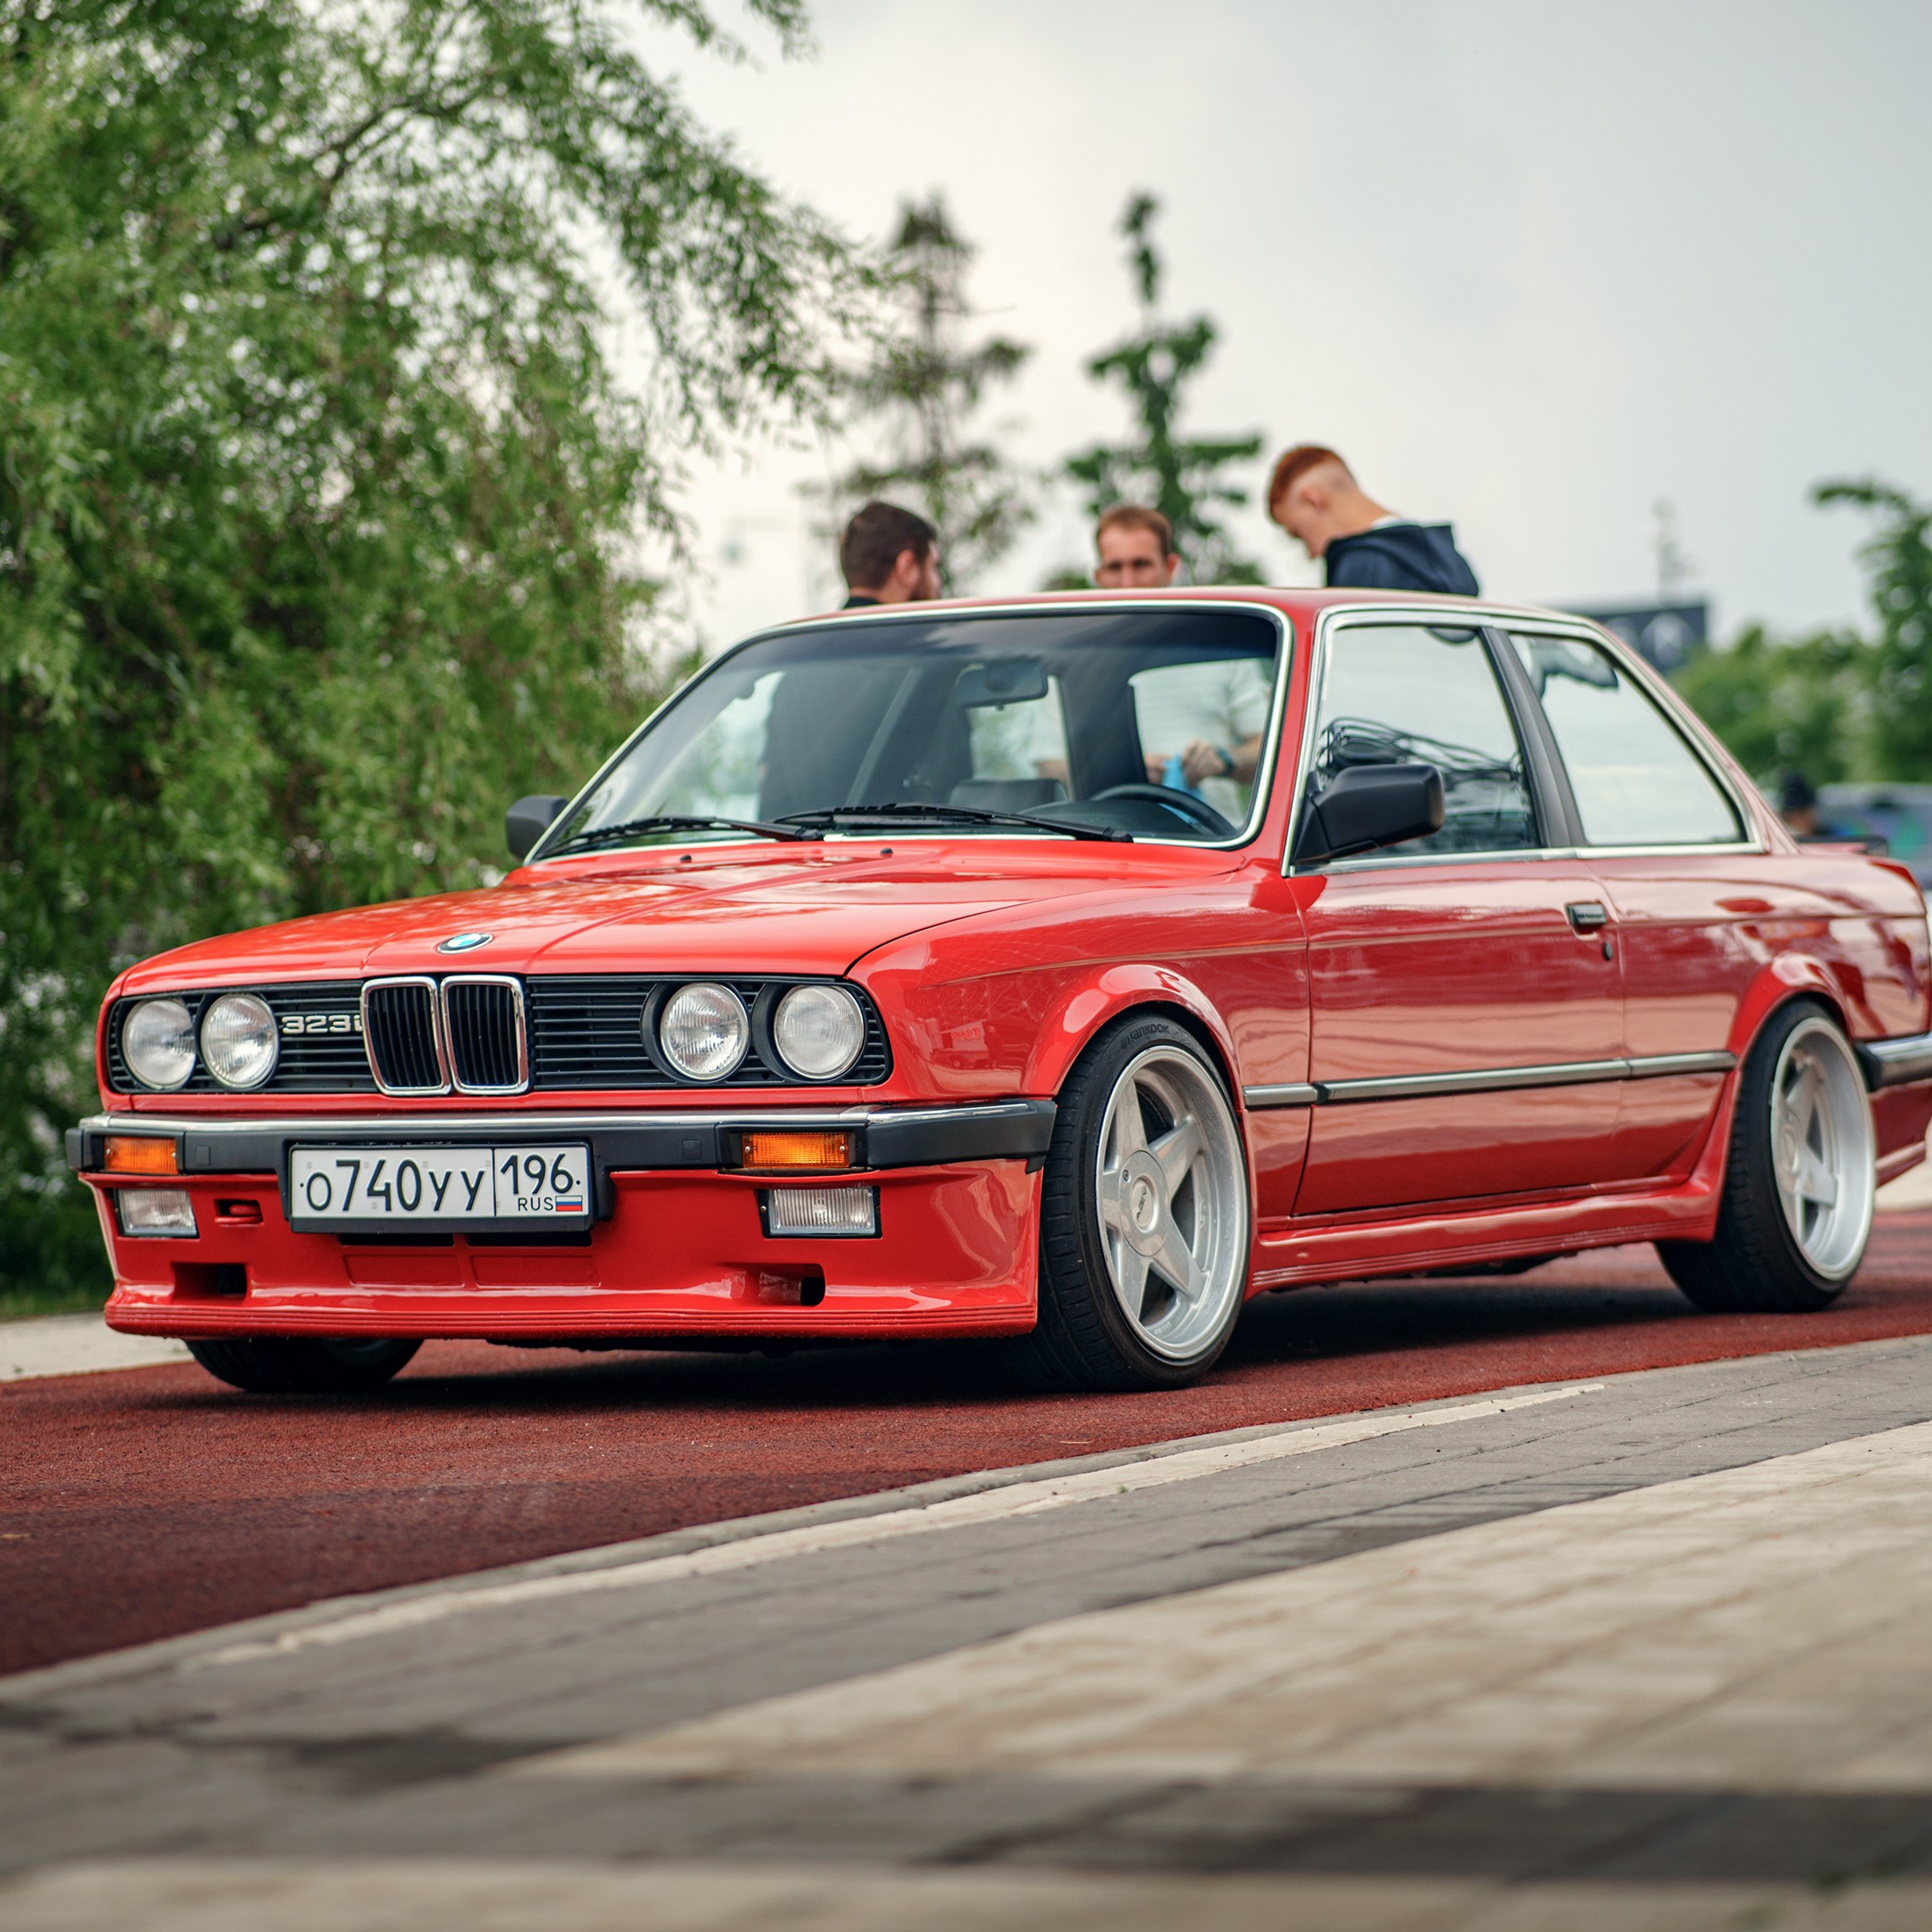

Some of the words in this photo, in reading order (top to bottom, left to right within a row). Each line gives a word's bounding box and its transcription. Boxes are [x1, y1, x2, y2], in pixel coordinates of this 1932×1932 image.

[281, 1014, 362, 1033] 323i
[500, 1152, 574, 1195] 196
[517, 1197, 554, 1212] RUS
